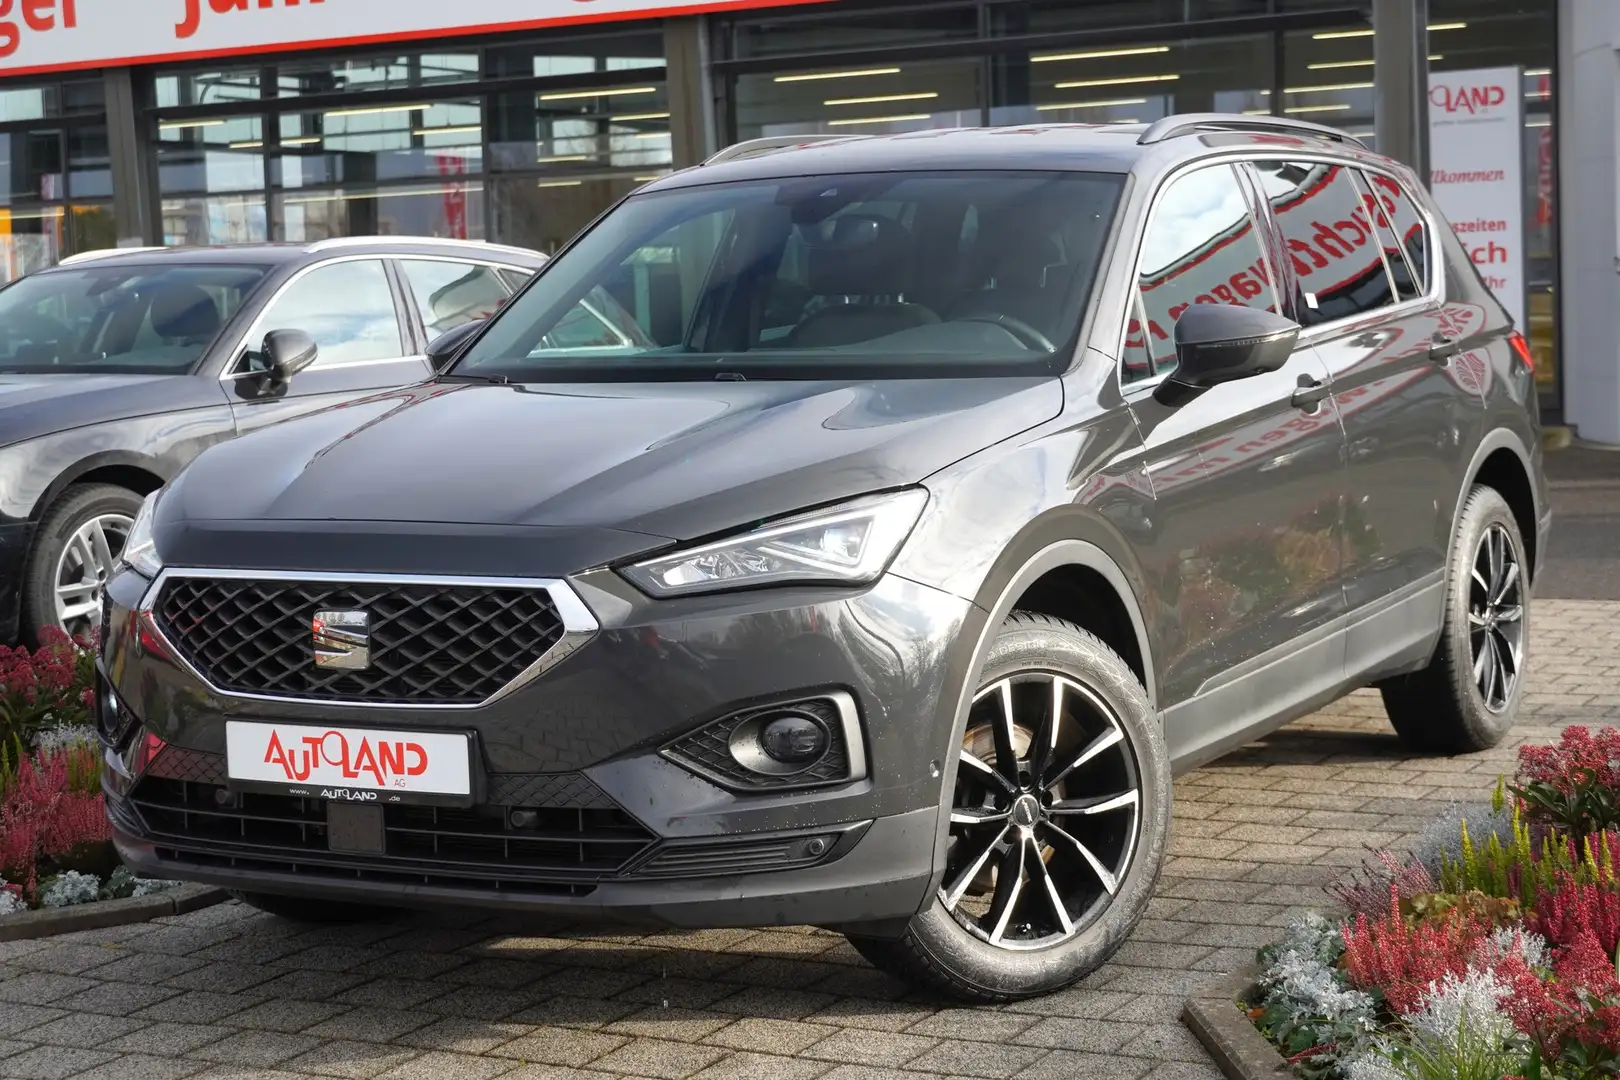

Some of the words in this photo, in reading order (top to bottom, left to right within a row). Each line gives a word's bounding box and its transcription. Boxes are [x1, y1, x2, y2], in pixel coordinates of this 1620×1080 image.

[264, 729, 428, 786] AUTOLAND
[394, 778, 406, 788] AG
[321, 788, 377, 801] AUTOLAND
